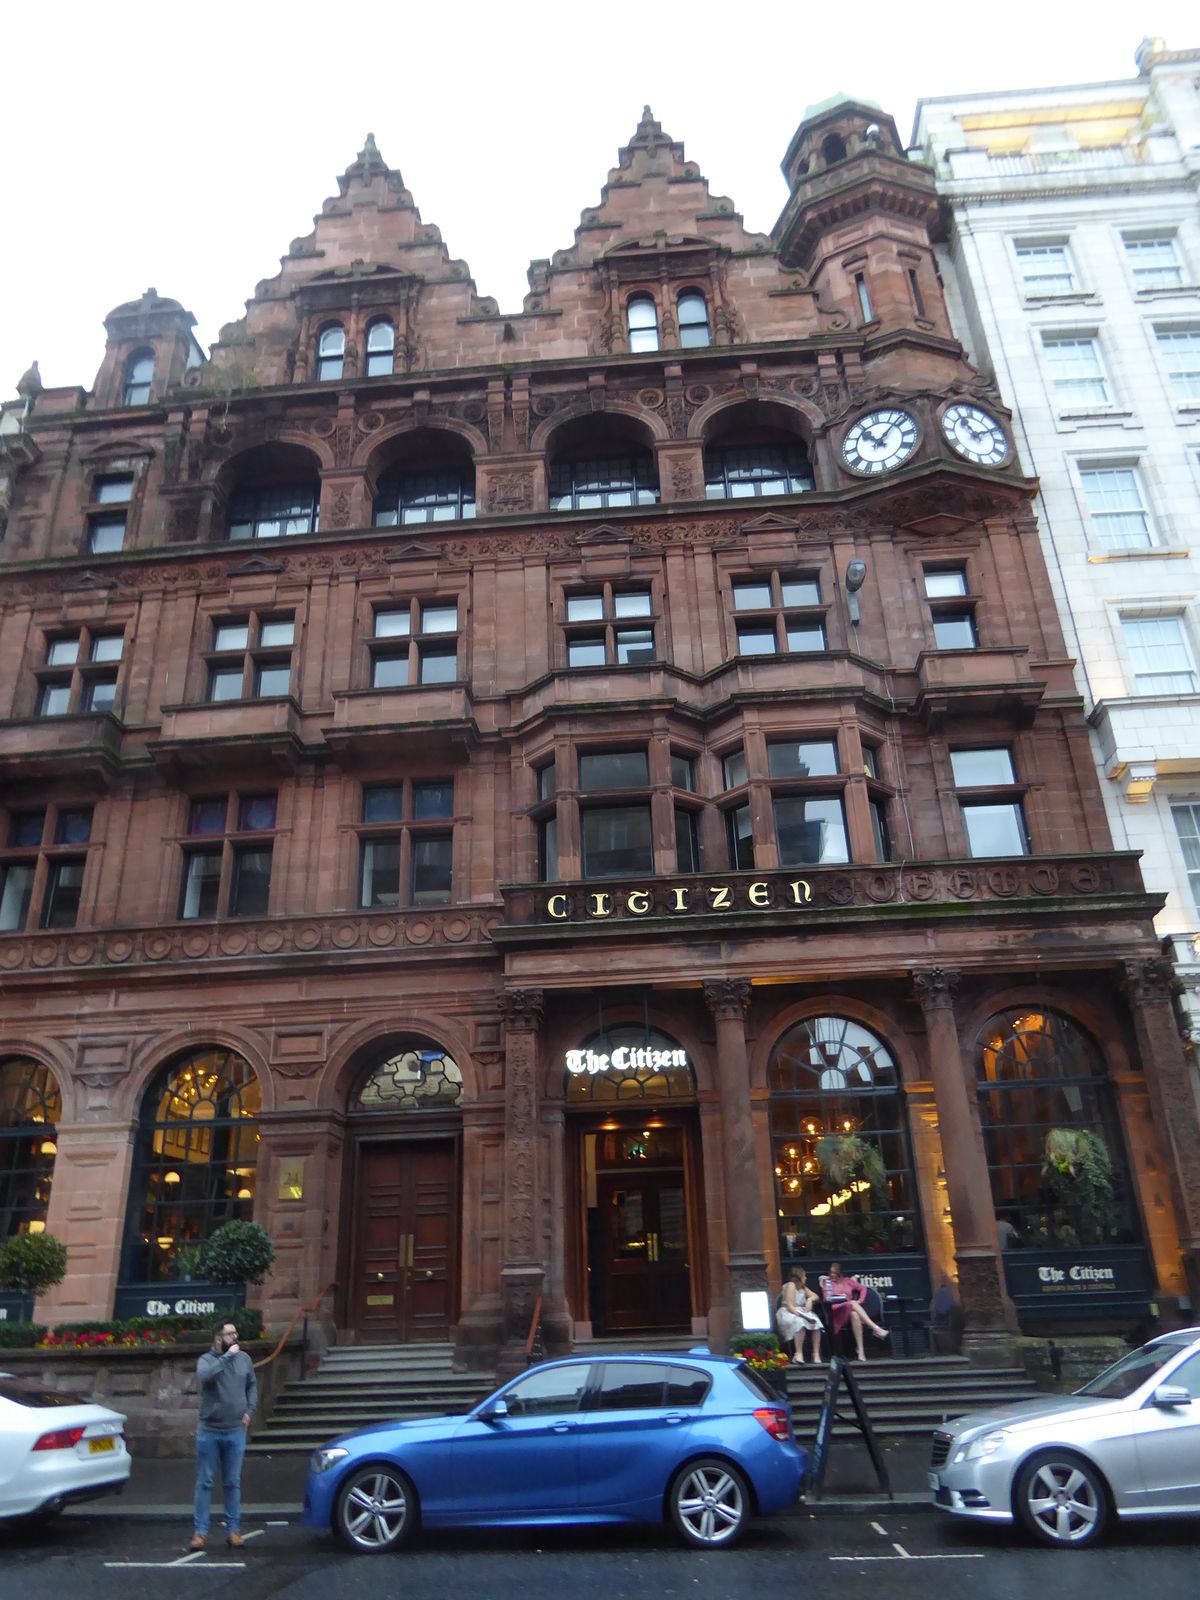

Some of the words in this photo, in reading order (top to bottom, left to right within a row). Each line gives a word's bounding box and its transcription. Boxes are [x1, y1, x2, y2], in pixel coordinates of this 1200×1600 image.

[546, 879, 813, 919] CITIZEN
[565, 1049, 610, 1075] The
[611, 1046, 687, 1072] Citizen
[1038, 1266, 1065, 1282] The
[1069, 1265, 1114, 1281] Citizen
[146, 1300, 171, 1316] The
[175, 1299, 215, 1316] Citizen
